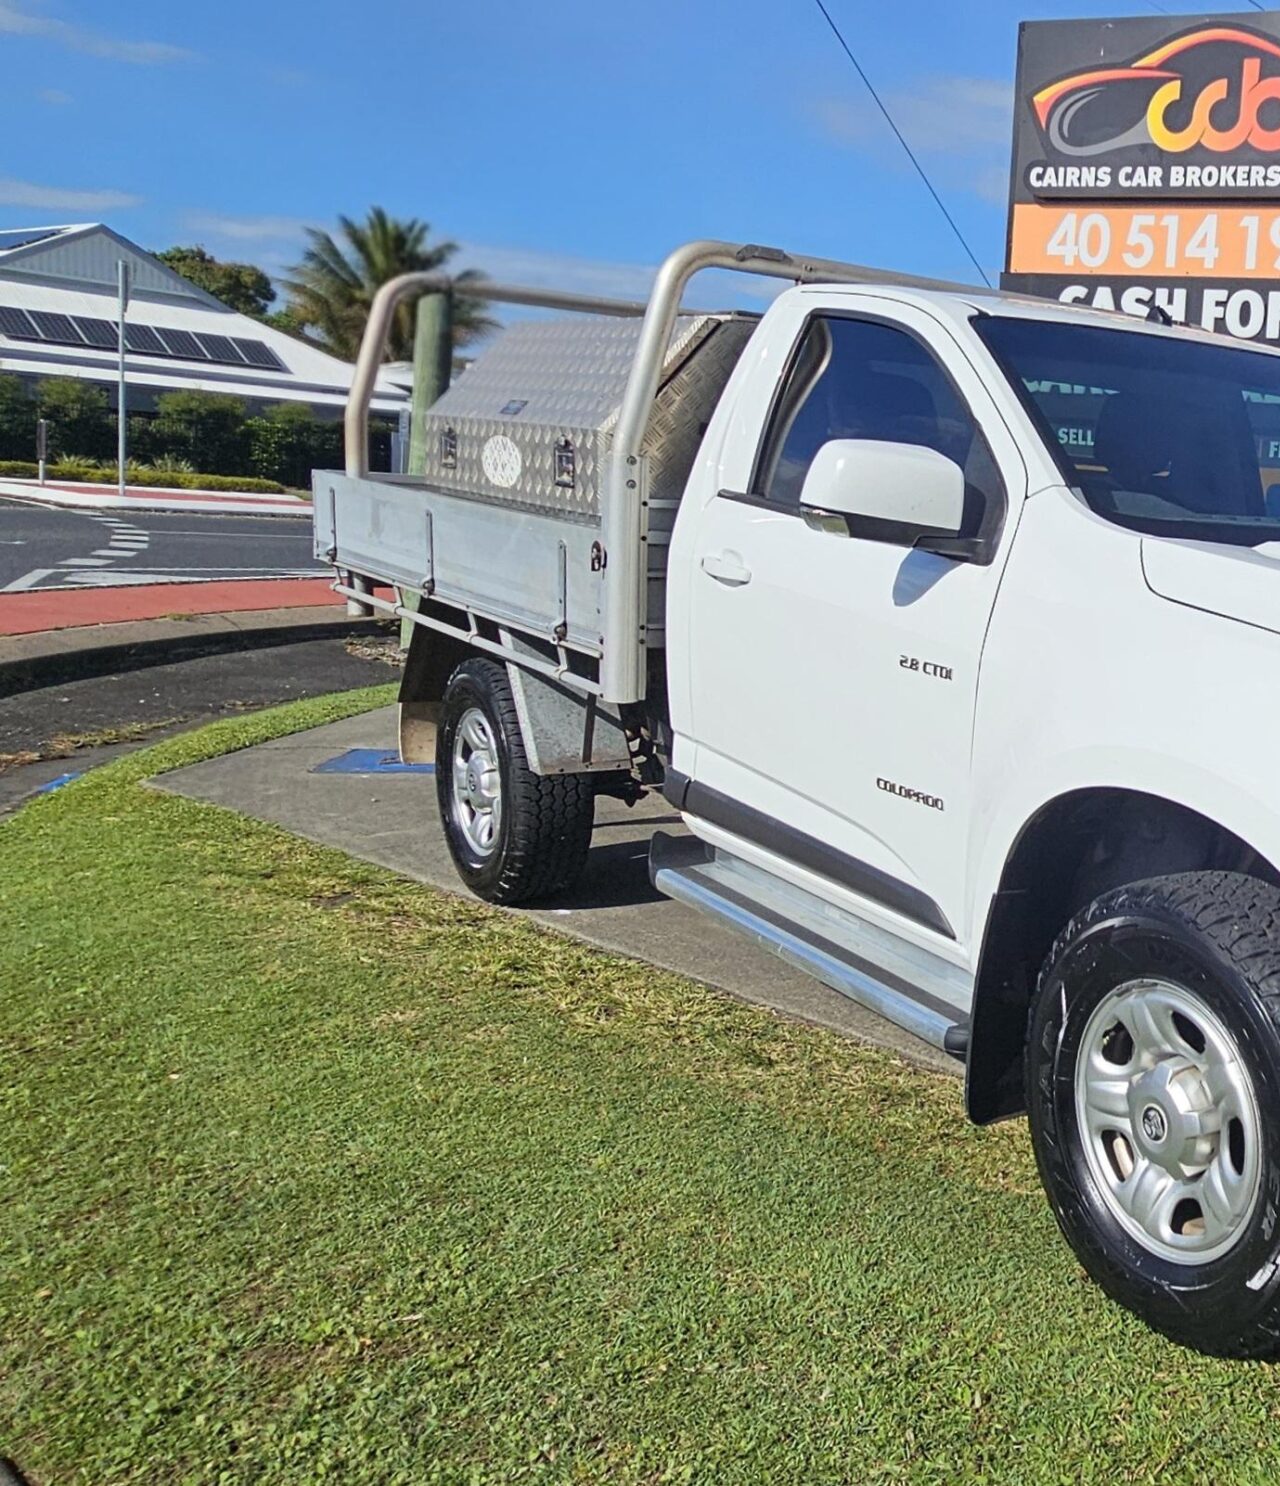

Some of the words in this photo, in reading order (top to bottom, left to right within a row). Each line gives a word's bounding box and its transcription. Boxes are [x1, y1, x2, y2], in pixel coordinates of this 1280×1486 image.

[1029, 165, 1111, 188] CAIRNS
[1118, 165, 1163, 188] CAR
[1046, 212, 1111, 268] 40
[1121, 213, 1220, 269] 514
[1057, 426, 1095, 446] SELL
[899, 654, 920, 671] 2.8
[876, 777, 945, 811] COLORADO
